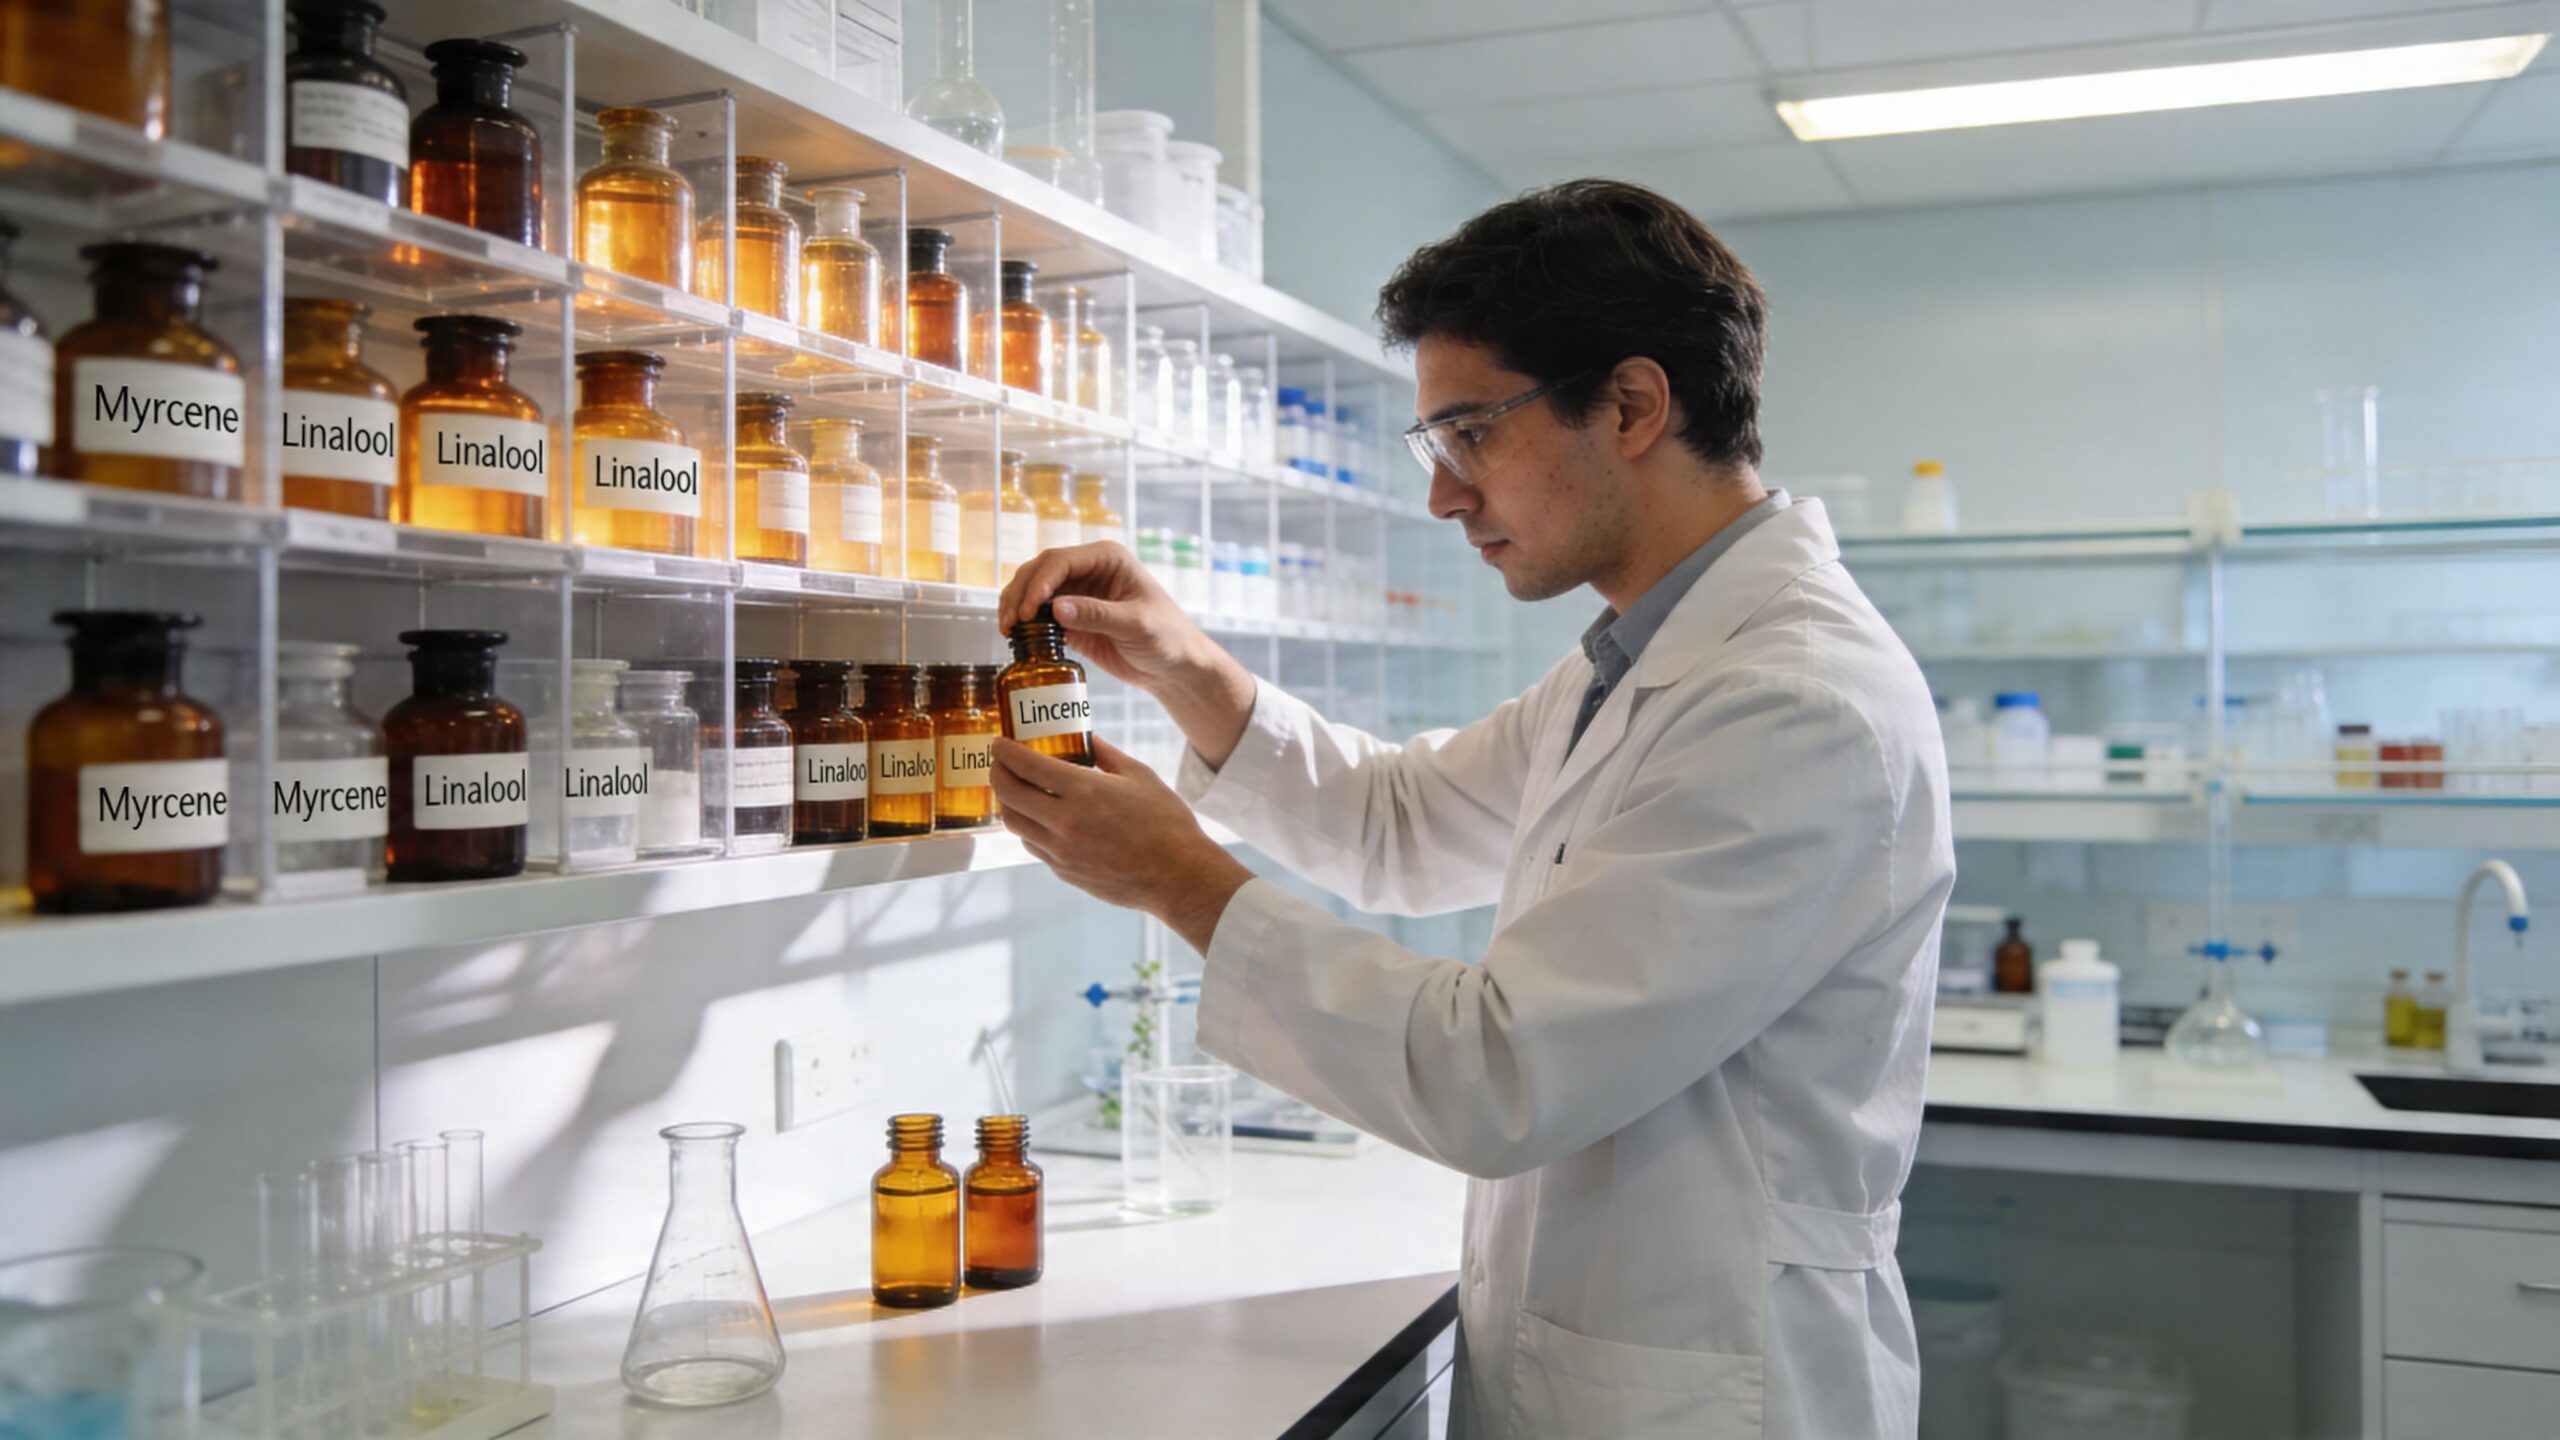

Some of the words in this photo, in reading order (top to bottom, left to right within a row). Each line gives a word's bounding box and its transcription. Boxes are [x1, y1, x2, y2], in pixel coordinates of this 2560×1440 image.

[94, 384, 240, 434] Myrcene
[282, 411, 395, 458] Linalool
[437, 430, 544, 475] Linalool
[595, 454, 697, 496] Linalool
[1019, 699, 1091, 725] Lincene
[273, 780, 387, 823] Myrcene
[425, 768, 527, 807] Linalool
[565, 762, 648, 798] Linalool
[98, 785, 227, 831] Myrcene
